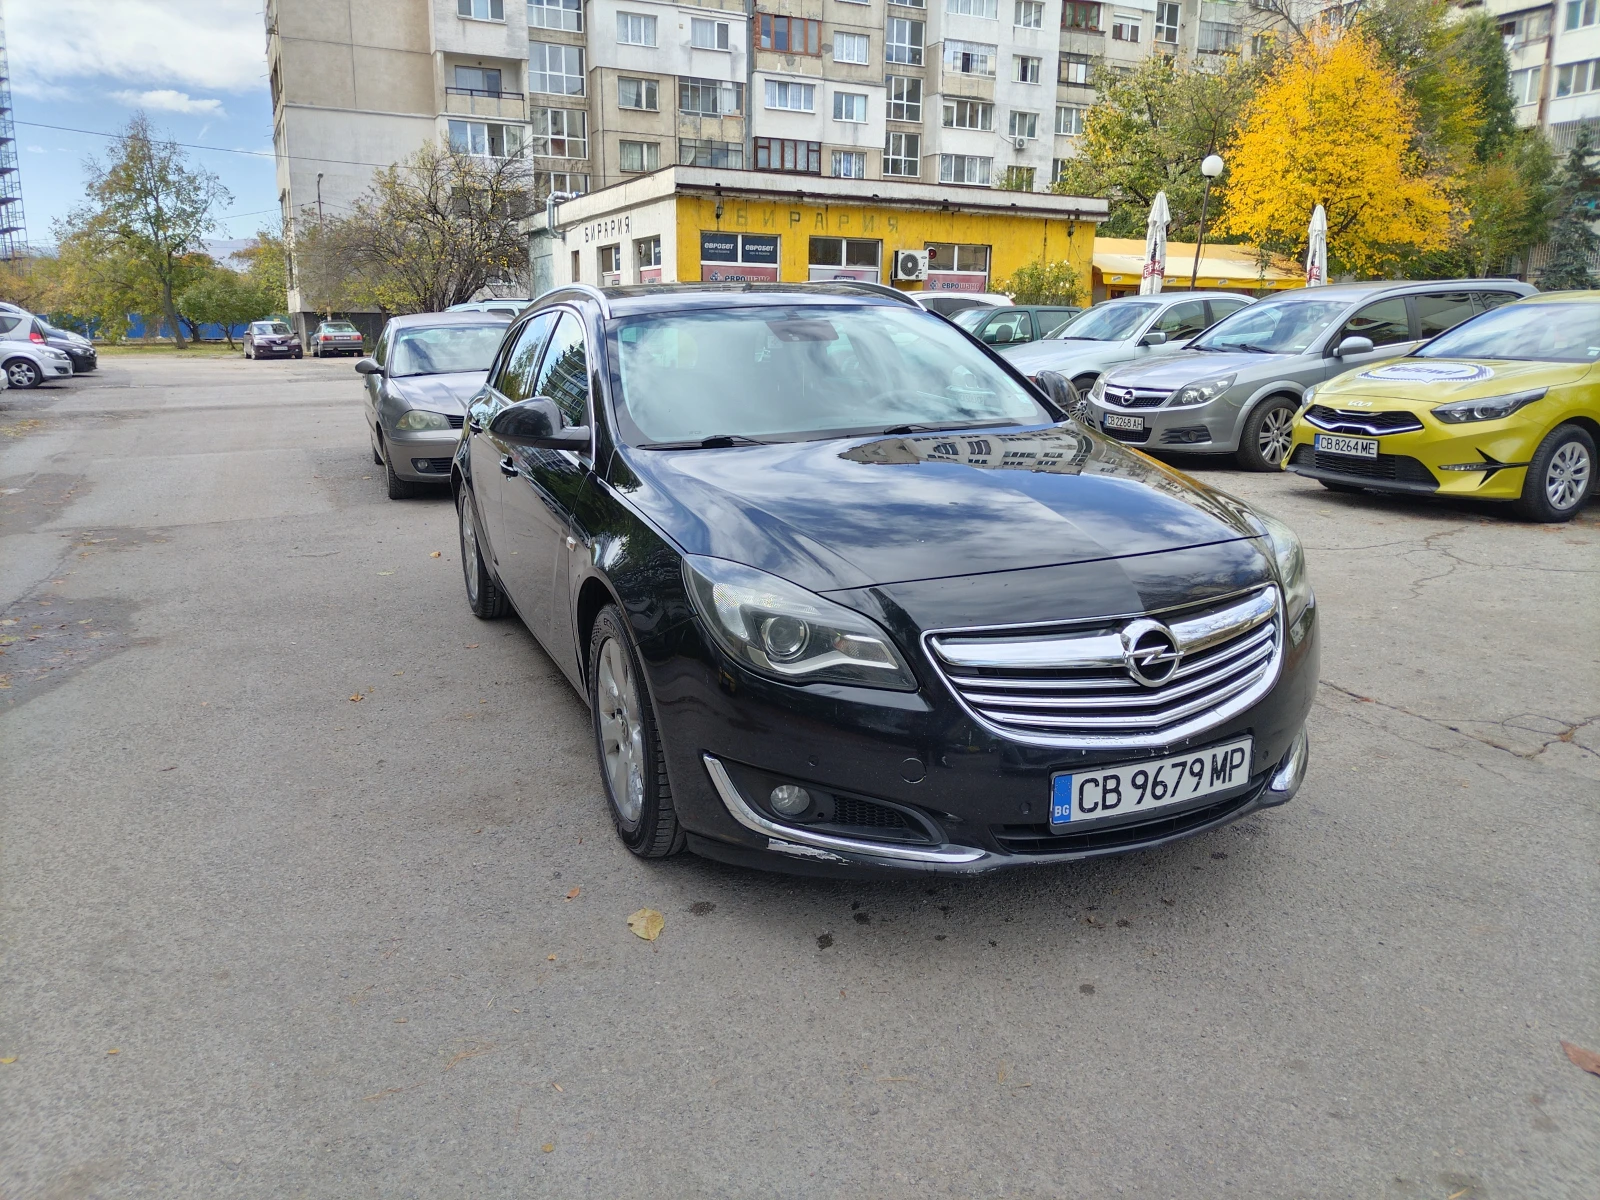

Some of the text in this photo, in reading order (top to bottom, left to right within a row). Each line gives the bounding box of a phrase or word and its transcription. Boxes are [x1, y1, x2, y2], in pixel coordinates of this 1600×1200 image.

[584, 215, 630, 243] БИРАРИЯ
[736, 207, 899, 234] БИРАРИЯ
[1107, 415, 1115, 426] CB
[1115, 416, 1132, 428] 2268
[1320, 437, 1333, 450] CB
[1334, 439, 1359, 454] 8264
[1360, 441, 1376, 455] ME
[1079, 747, 1246, 813] CB 9679 MP
[1054, 804, 1070, 817] BG
